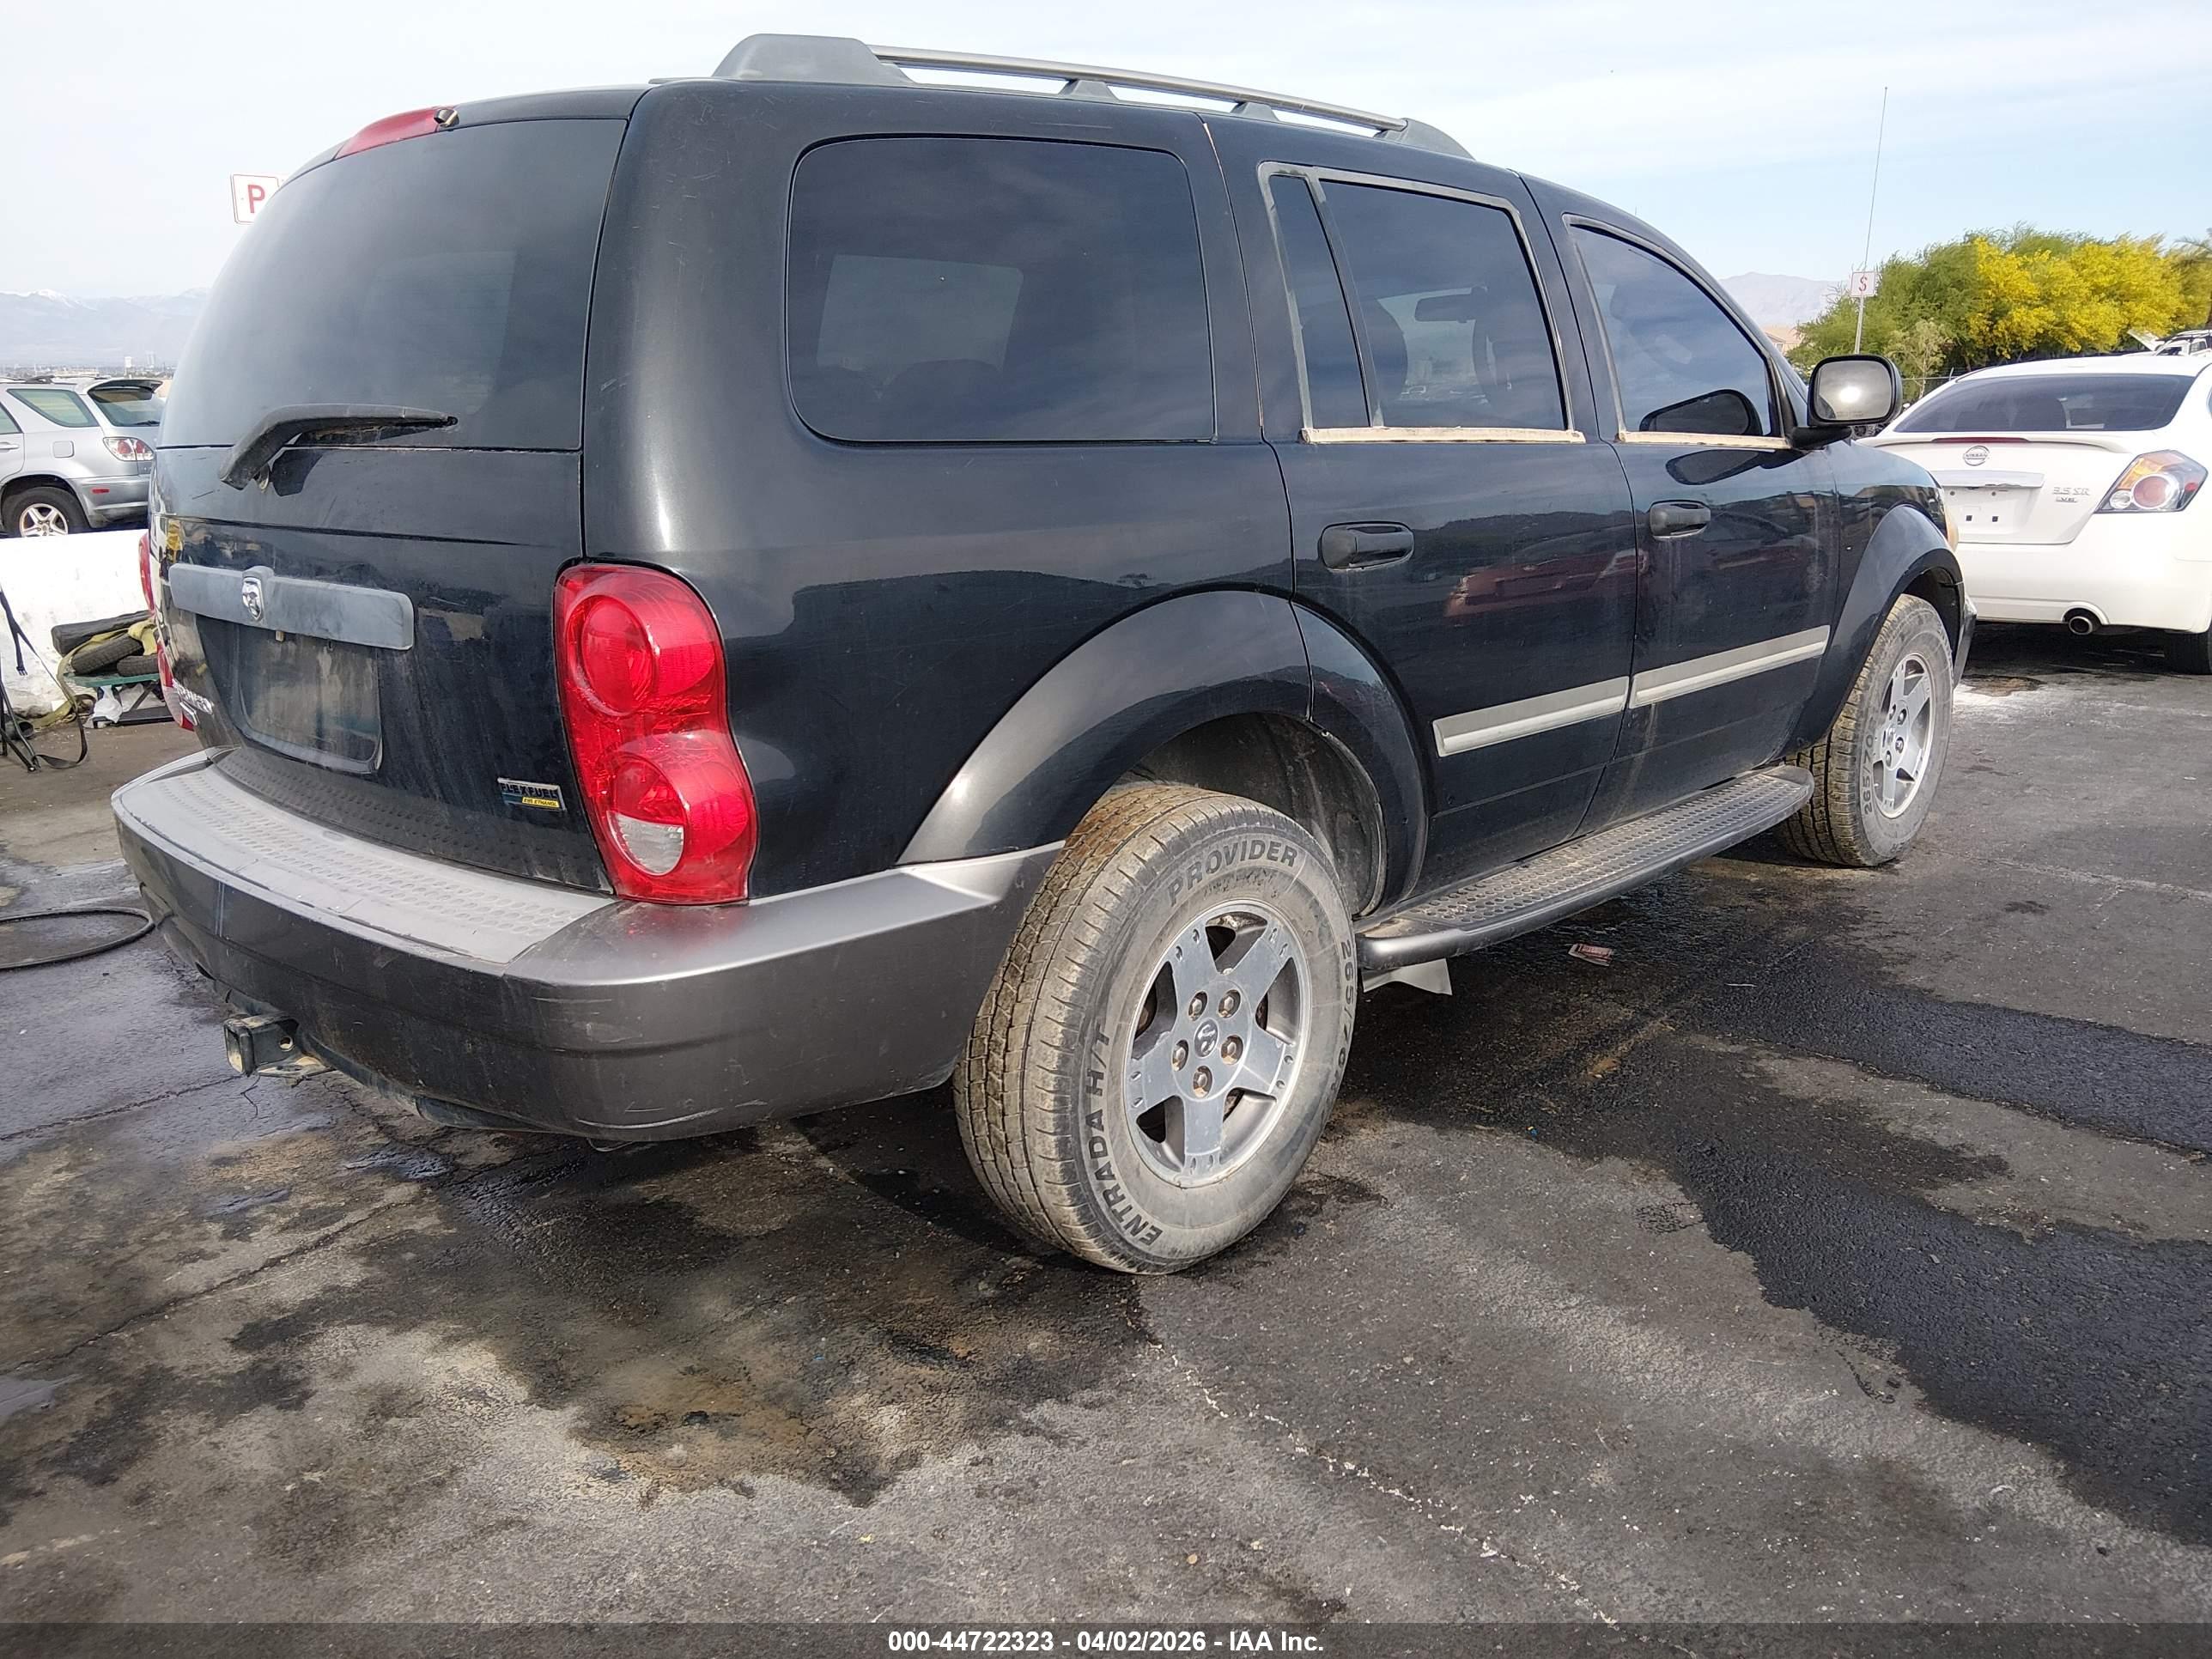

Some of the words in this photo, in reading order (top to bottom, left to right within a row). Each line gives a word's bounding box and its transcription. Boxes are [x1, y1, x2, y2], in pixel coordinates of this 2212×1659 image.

[247, 184, 265, 214] P
[1167, 839, 1298, 908] PROVIDER
[1085, 1021, 1110, 1097] H/T
[1085, 1109, 1164, 1247] ENTRADA
